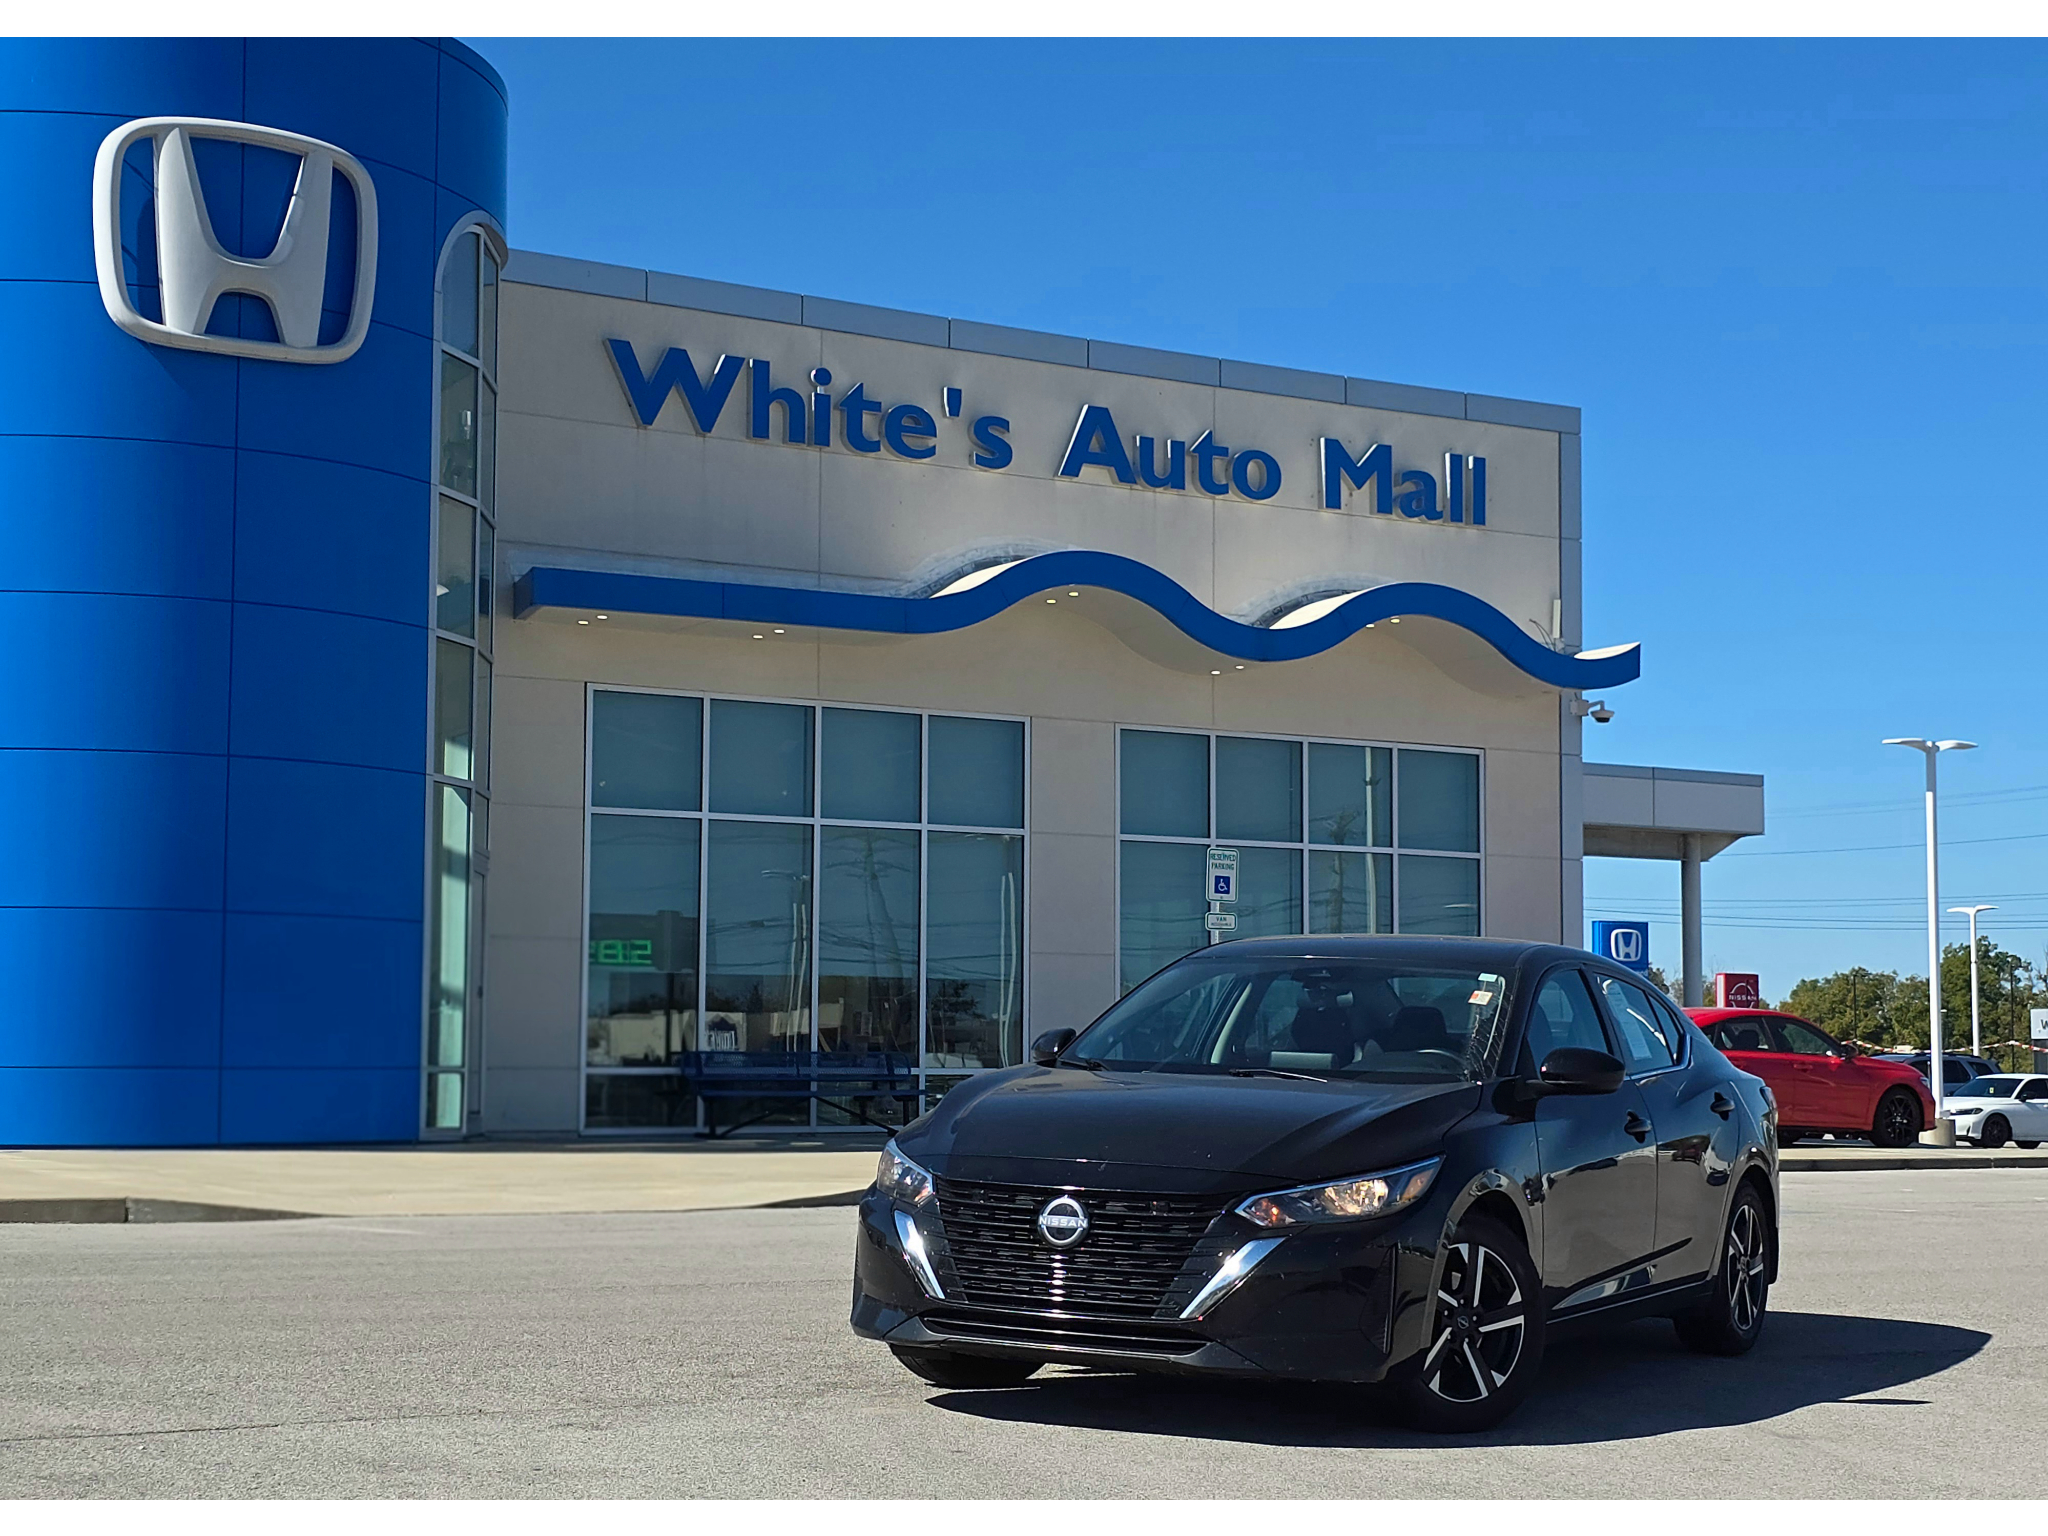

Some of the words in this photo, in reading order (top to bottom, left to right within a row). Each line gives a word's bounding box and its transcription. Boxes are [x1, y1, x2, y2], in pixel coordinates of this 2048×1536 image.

[604, 338, 1013, 470] White's
[1057, 403, 1281, 501] Auto
[1319, 437, 1487, 527] Mall
[1210, 852, 1236, 861] RESERVED
[1211, 861, 1235, 869] PARKING
[1039, 1215, 1088, 1229] NISSAN
